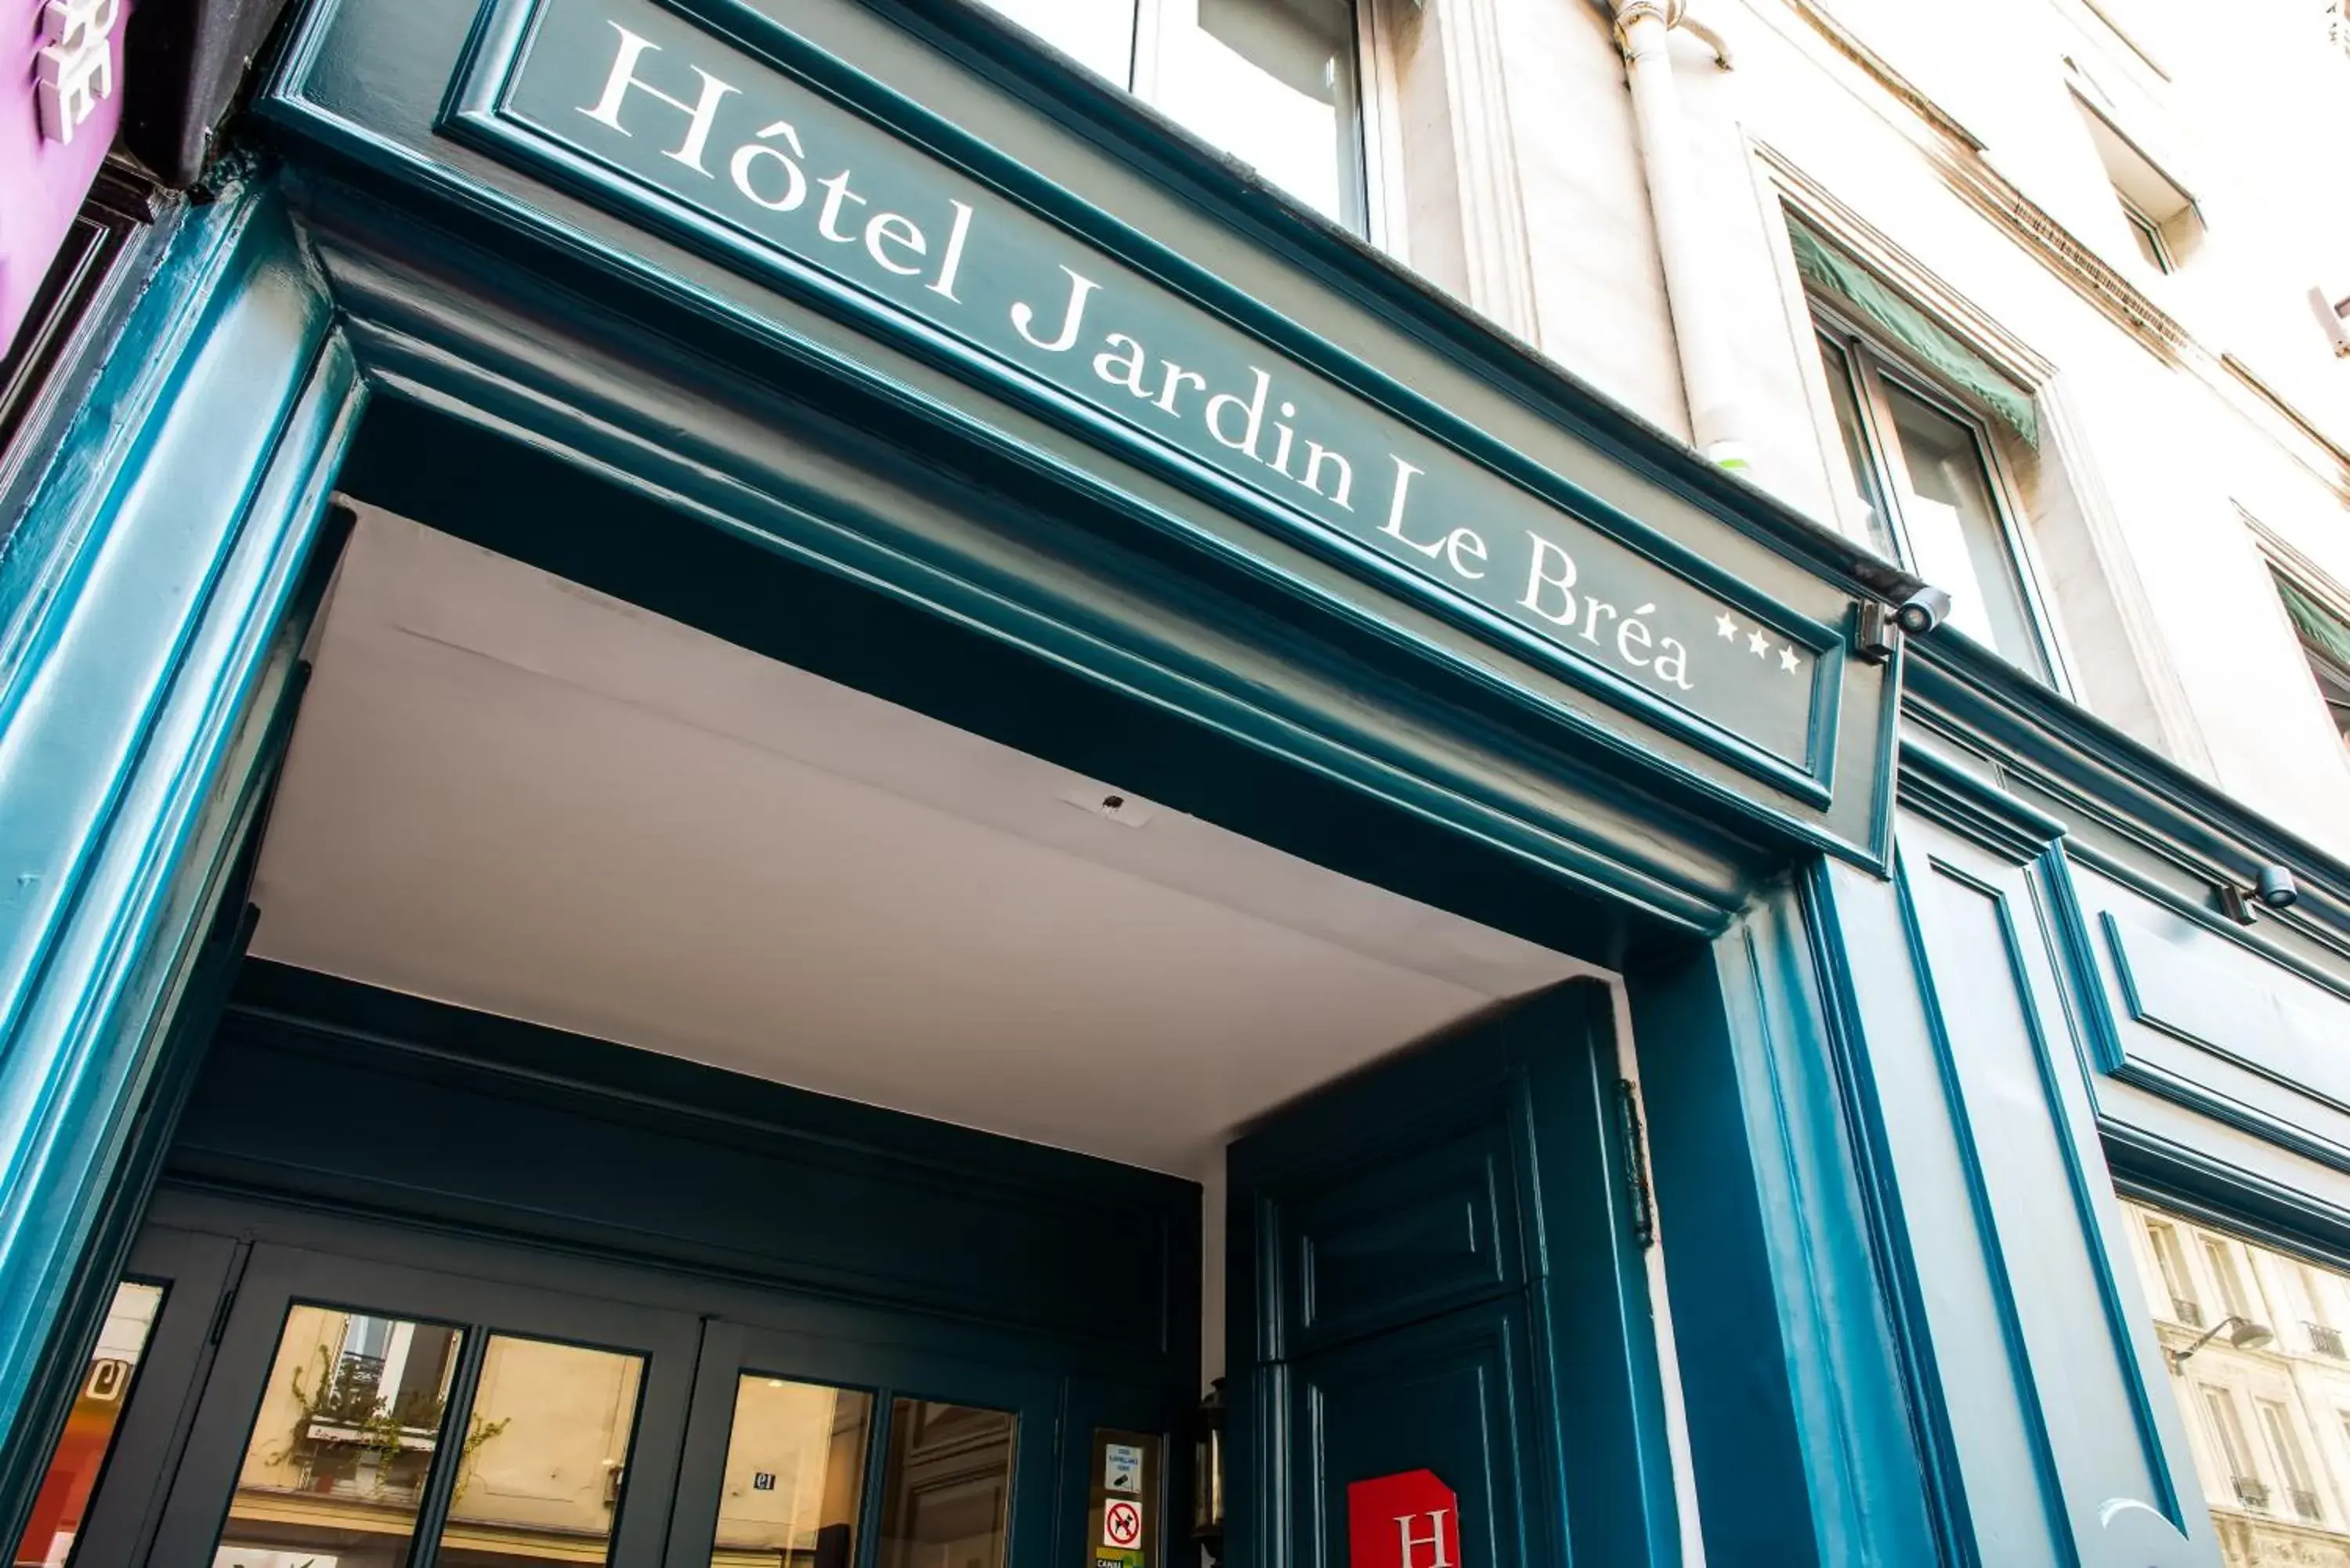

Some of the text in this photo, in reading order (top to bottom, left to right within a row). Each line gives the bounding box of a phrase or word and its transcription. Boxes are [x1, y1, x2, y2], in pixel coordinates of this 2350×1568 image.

[575, 20, 1694, 690] Hôtel Jardin Le Bréa
[1392, 1508, 1454, 1568] H
